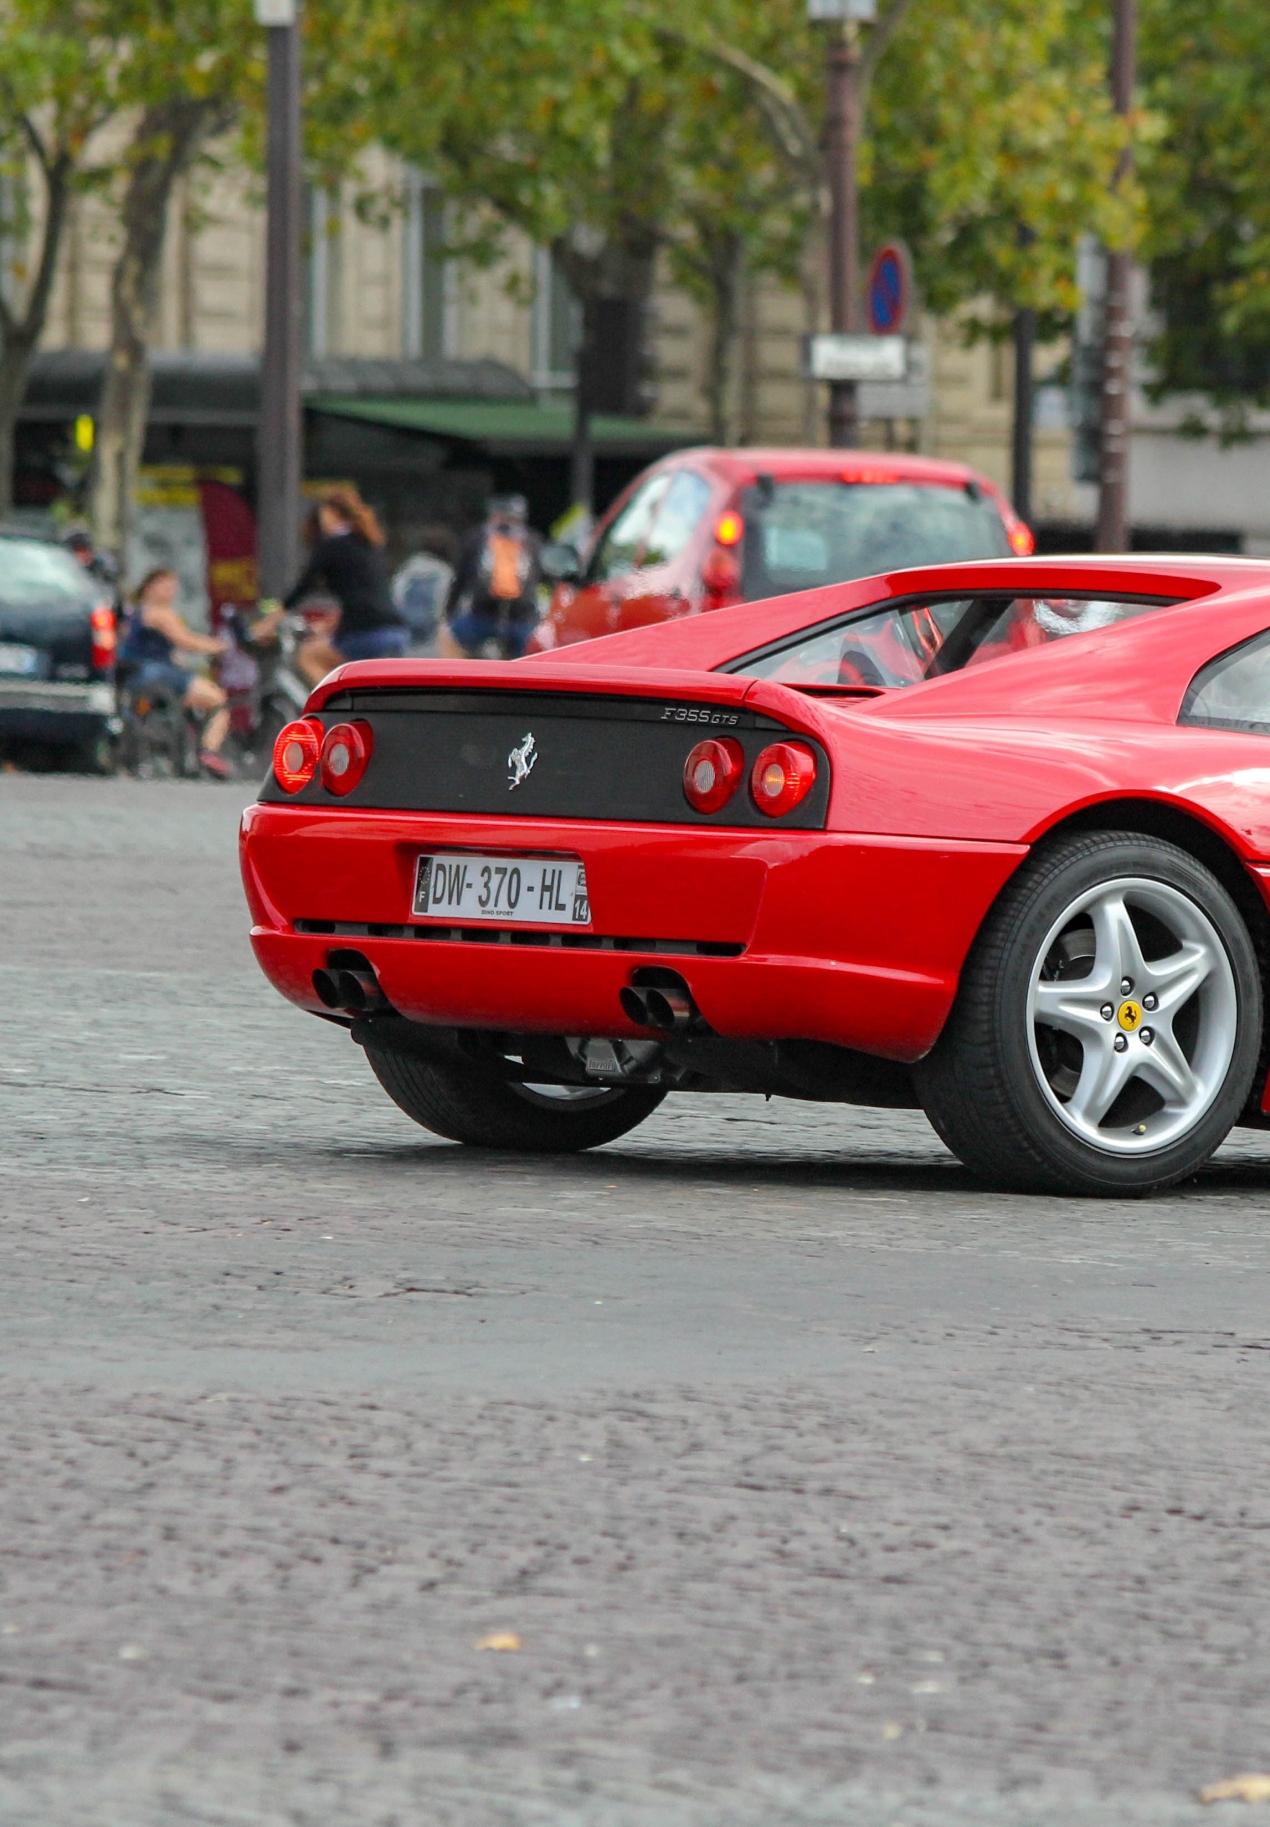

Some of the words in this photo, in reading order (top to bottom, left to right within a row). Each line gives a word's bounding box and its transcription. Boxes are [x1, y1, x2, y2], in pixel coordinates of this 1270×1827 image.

[660, 707, 711, 723] F355
[711, 714, 738, 725] GTS
[418, 891, 426, 903] F
[574, 899, 588, 920] 14
